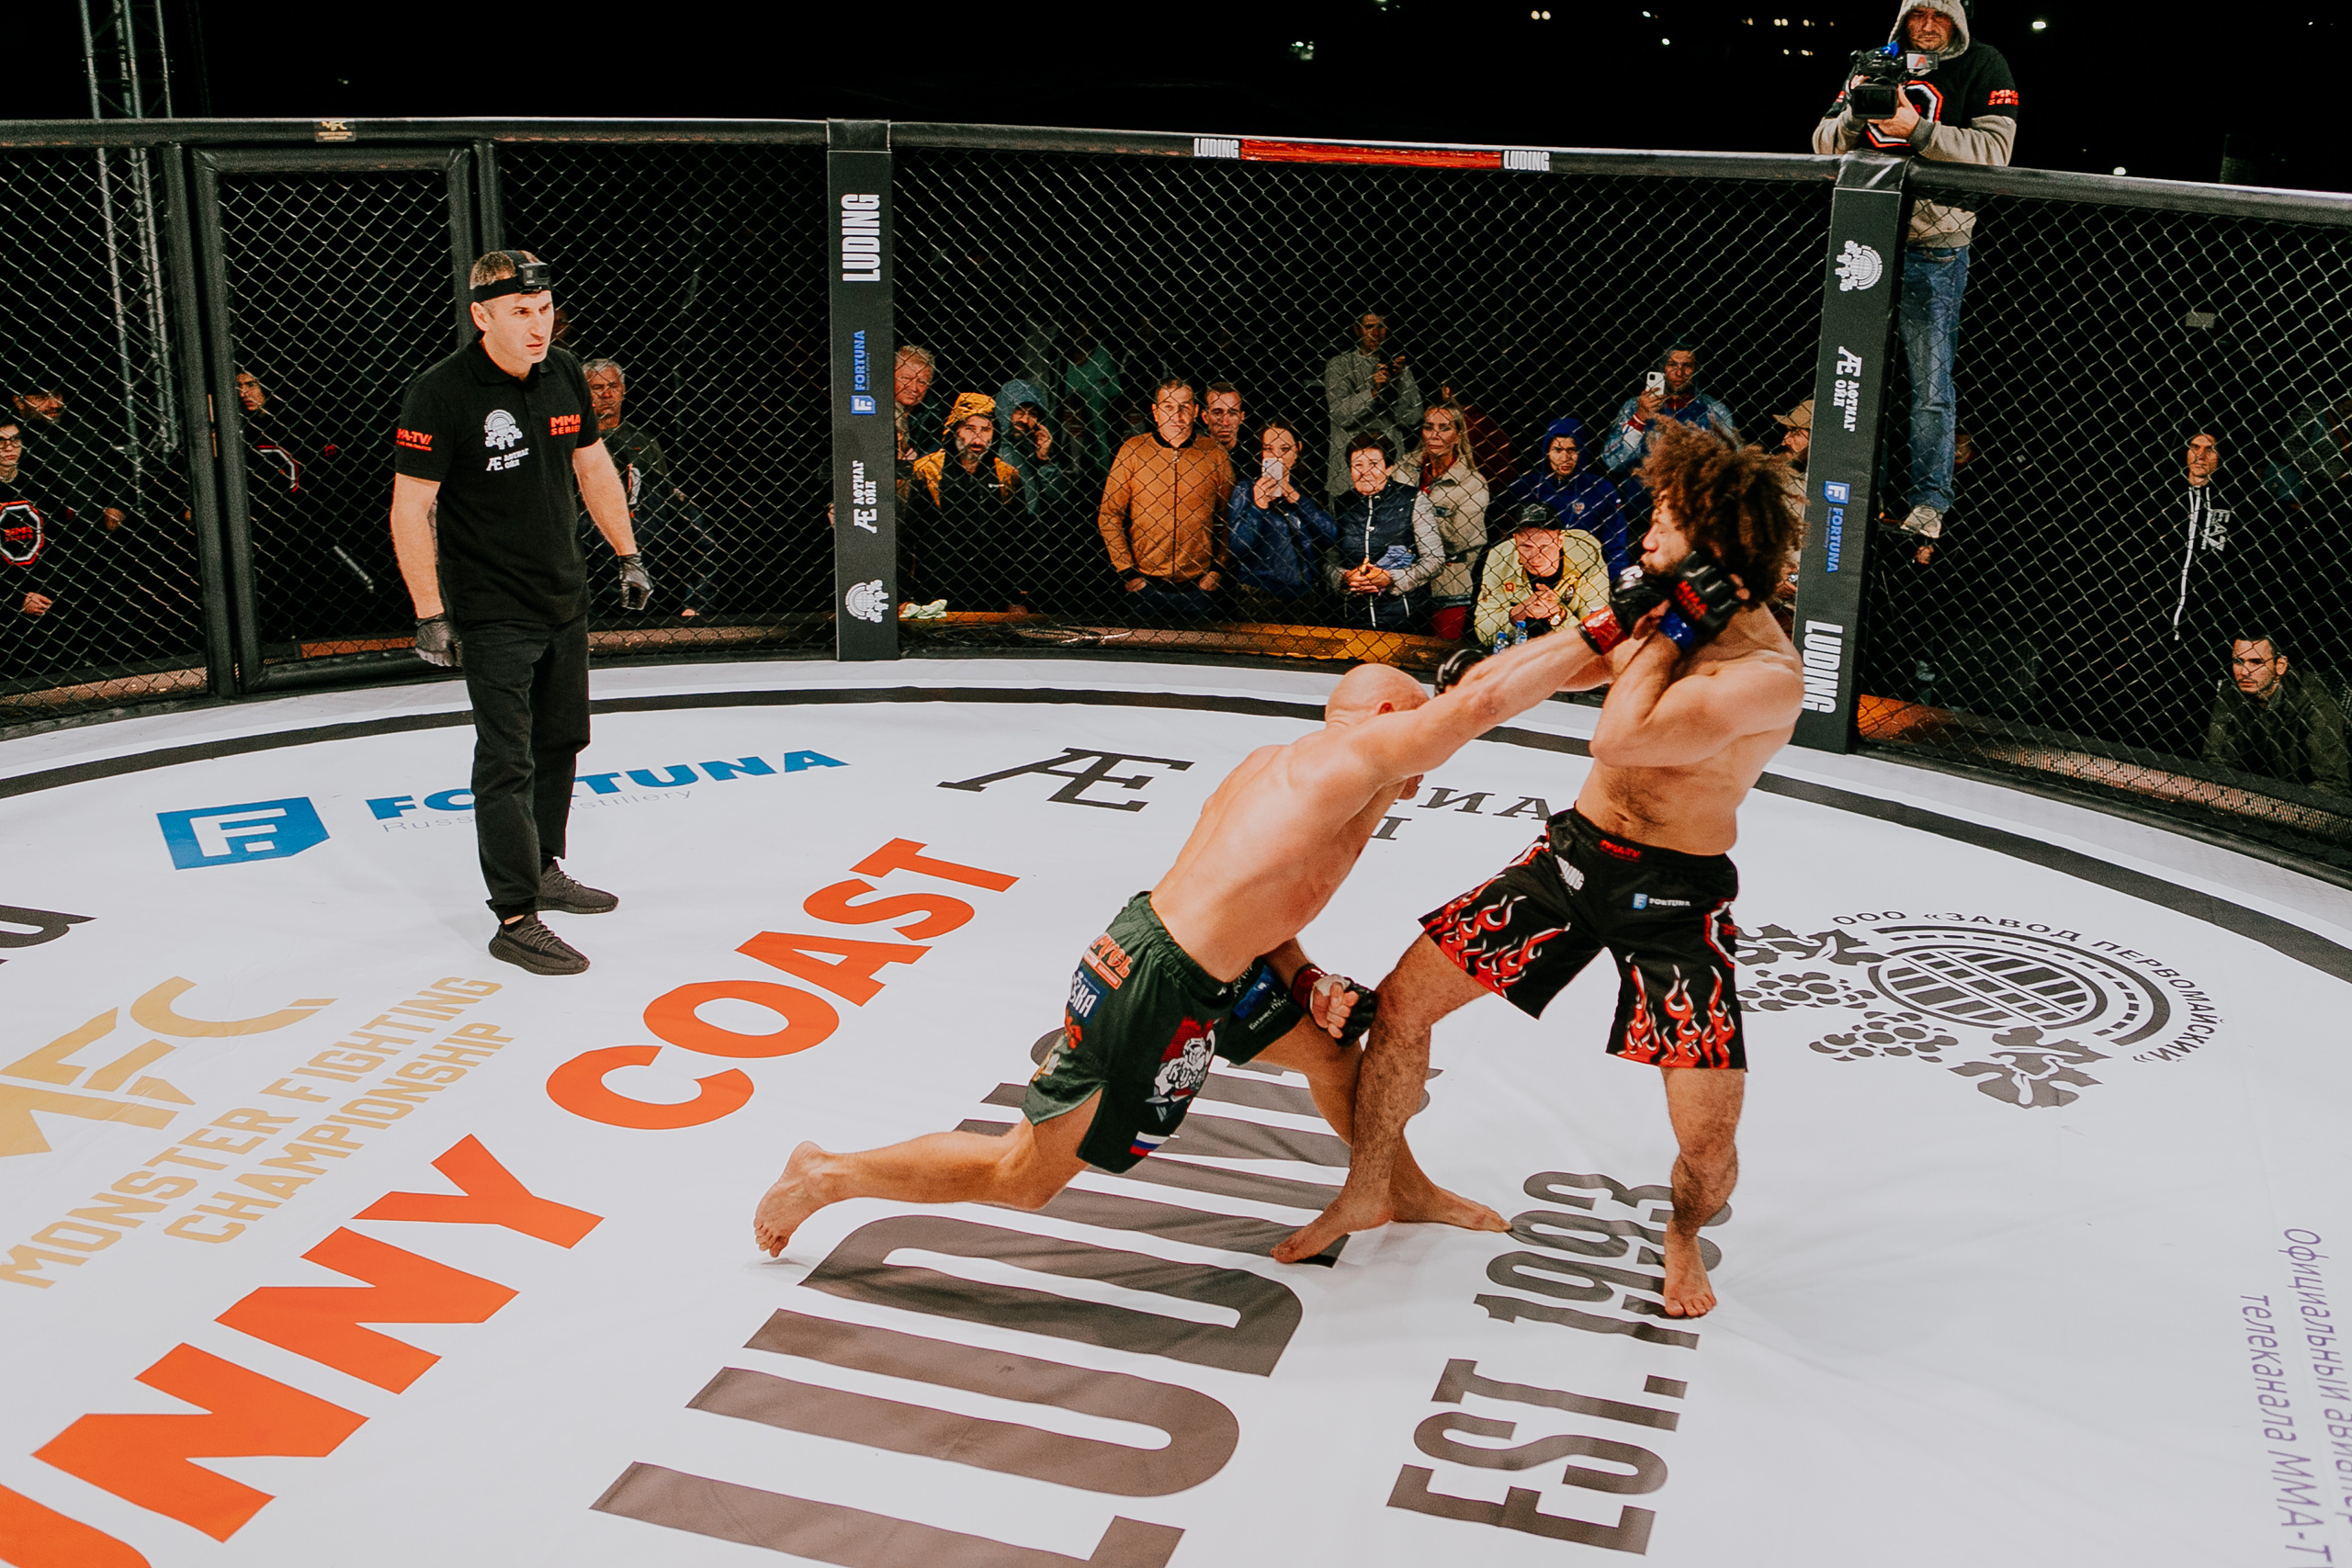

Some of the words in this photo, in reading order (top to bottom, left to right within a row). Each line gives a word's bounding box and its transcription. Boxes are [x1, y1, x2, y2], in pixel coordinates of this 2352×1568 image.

[1193, 138, 1239, 158] LUDING
[1503, 150, 1550, 172] LUDING
[841, 193, 880, 282] LUDING
[853, 330, 866, 392] FORTUNA
[550, 414, 581, 428] MMA
[550, 424, 581, 436] SERIE
[1826, 506, 1844, 573] FORTUNA
[1802, 620, 1844, 715] LUDING
[365, 750, 851, 821] FOTUNA
[1649, 897, 1691, 908] FORTUNA
[546, 837, 1021, 1131] COAST
[0, 1108, 301, 1290] MONSTER
[259, 976, 503, 1103] FIGHTING
[164, 1022, 514, 1245] CHAMPIONSHIP
[1473, 1171, 1734, 1351] 1993
[2240, 1294, 2298, 1443] телеканала
[1385, 1358, 1689, 1557] EST.
